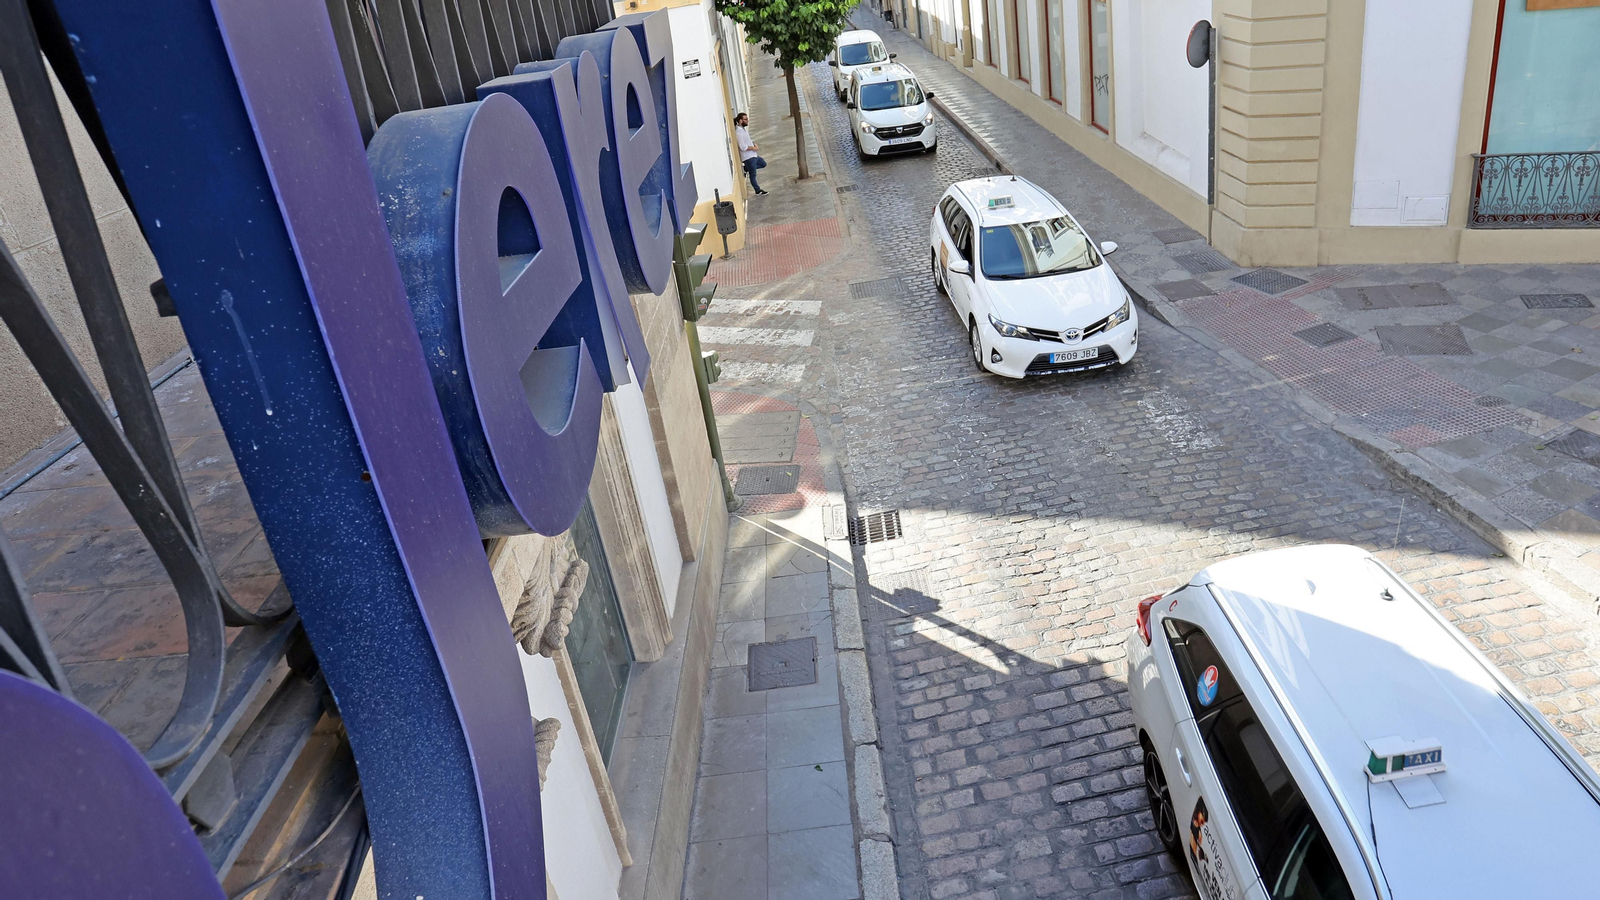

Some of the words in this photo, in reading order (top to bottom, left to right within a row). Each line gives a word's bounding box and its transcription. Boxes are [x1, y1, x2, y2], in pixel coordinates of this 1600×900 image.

[1055, 352, 1077, 362] 7609
[1081, 349, 1096, 358] JBZ
[1408, 751, 1438, 765] TAXI
